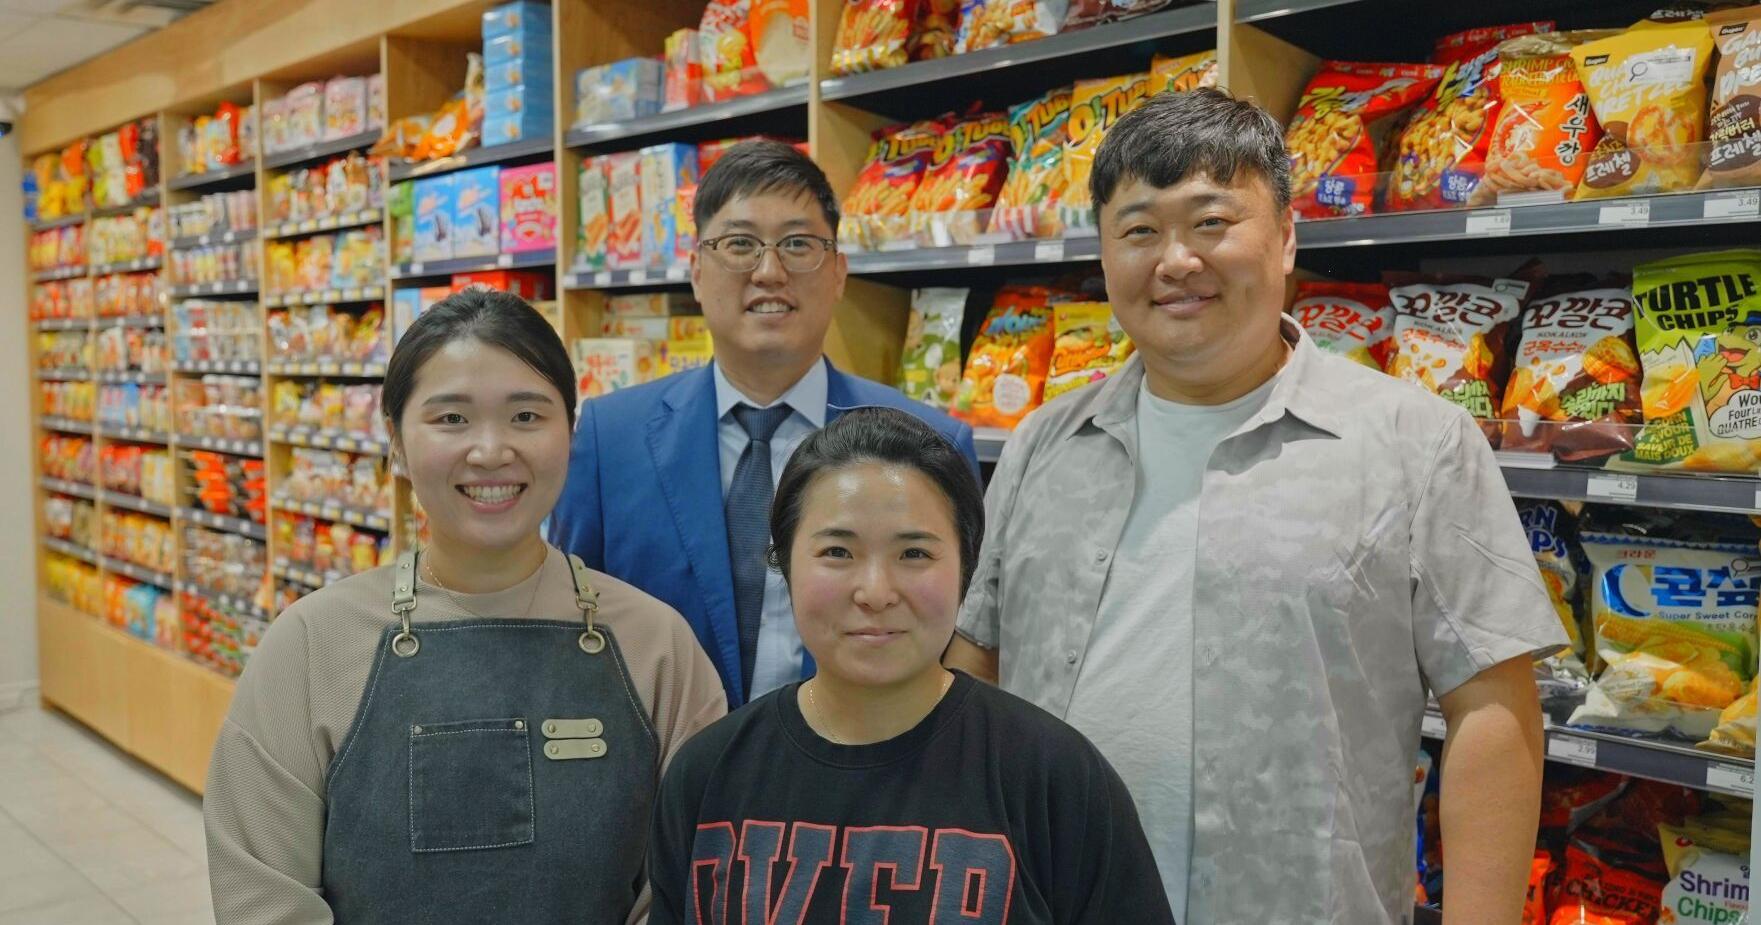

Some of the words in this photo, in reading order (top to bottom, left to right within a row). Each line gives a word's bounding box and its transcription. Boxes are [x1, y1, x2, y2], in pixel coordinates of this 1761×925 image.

[1555, 94, 1589, 165] 새우깡
[1397, 290, 1503, 326] 꼬깔콘
[1632, 273, 1757, 319] TURTLE
[1523, 297, 1632, 331] 꼬깔콘
[1657, 303, 1739, 331] CHIPS
[1658, 611, 1690, 621] Super
[1695, 611, 1729, 620] Sweet
[1678, 896, 1741, 925] Chips
